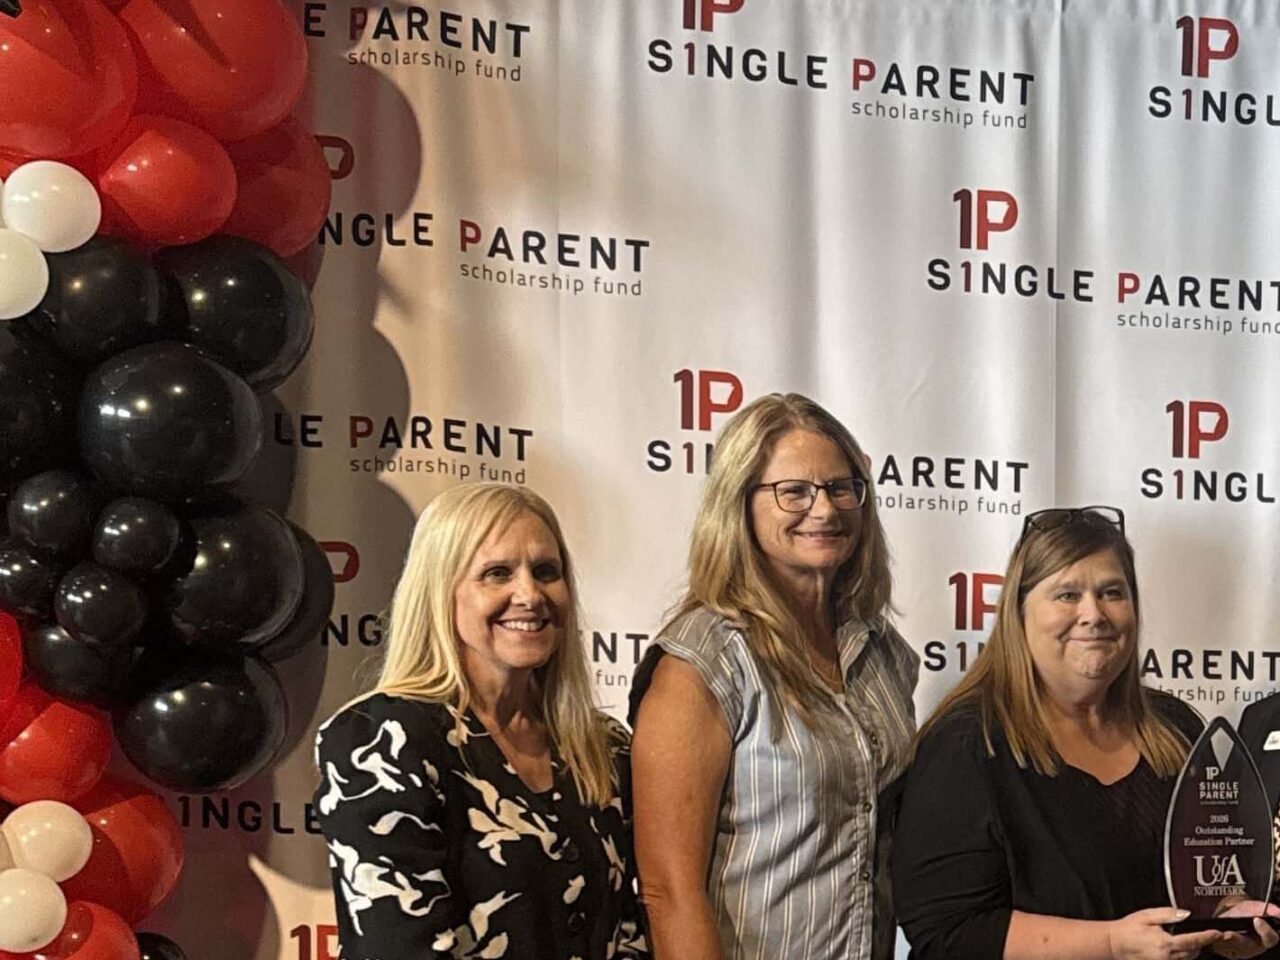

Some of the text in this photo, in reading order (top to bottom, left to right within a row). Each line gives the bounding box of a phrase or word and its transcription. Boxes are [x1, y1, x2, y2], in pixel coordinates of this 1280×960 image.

[350, 7, 530, 58] PARENT
[1176, 15, 1239, 78] 1P
[348, 48, 521, 81] scholarship fund
[852, 58, 1034, 106] PARENT
[852, 100, 1028, 129] scholarship fund
[953, 188, 1018, 250] 1P
[318, 212, 650, 273] NGLE PARENT
[460, 262, 642, 296] scholarship fund
[1117, 312, 1232, 335] scholarship
[673, 369, 744, 431] 1P
[349, 415, 533, 461] PARENT
[1166, 400, 1229, 459] 1P
[350, 455, 526, 485] scholarship fund
[877, 455, 1029, 494] ARENT
[876, 493, 1022, 515] olarship fund
[596, 669, 627, 687] fun
[1200, 790, 1239, 800] PARENT
[178, 795, 322, 835] 1NGLE
[1195, 825, 1244, 836] Outstanding
[1184, 837, 1255, 847] Education Partner
